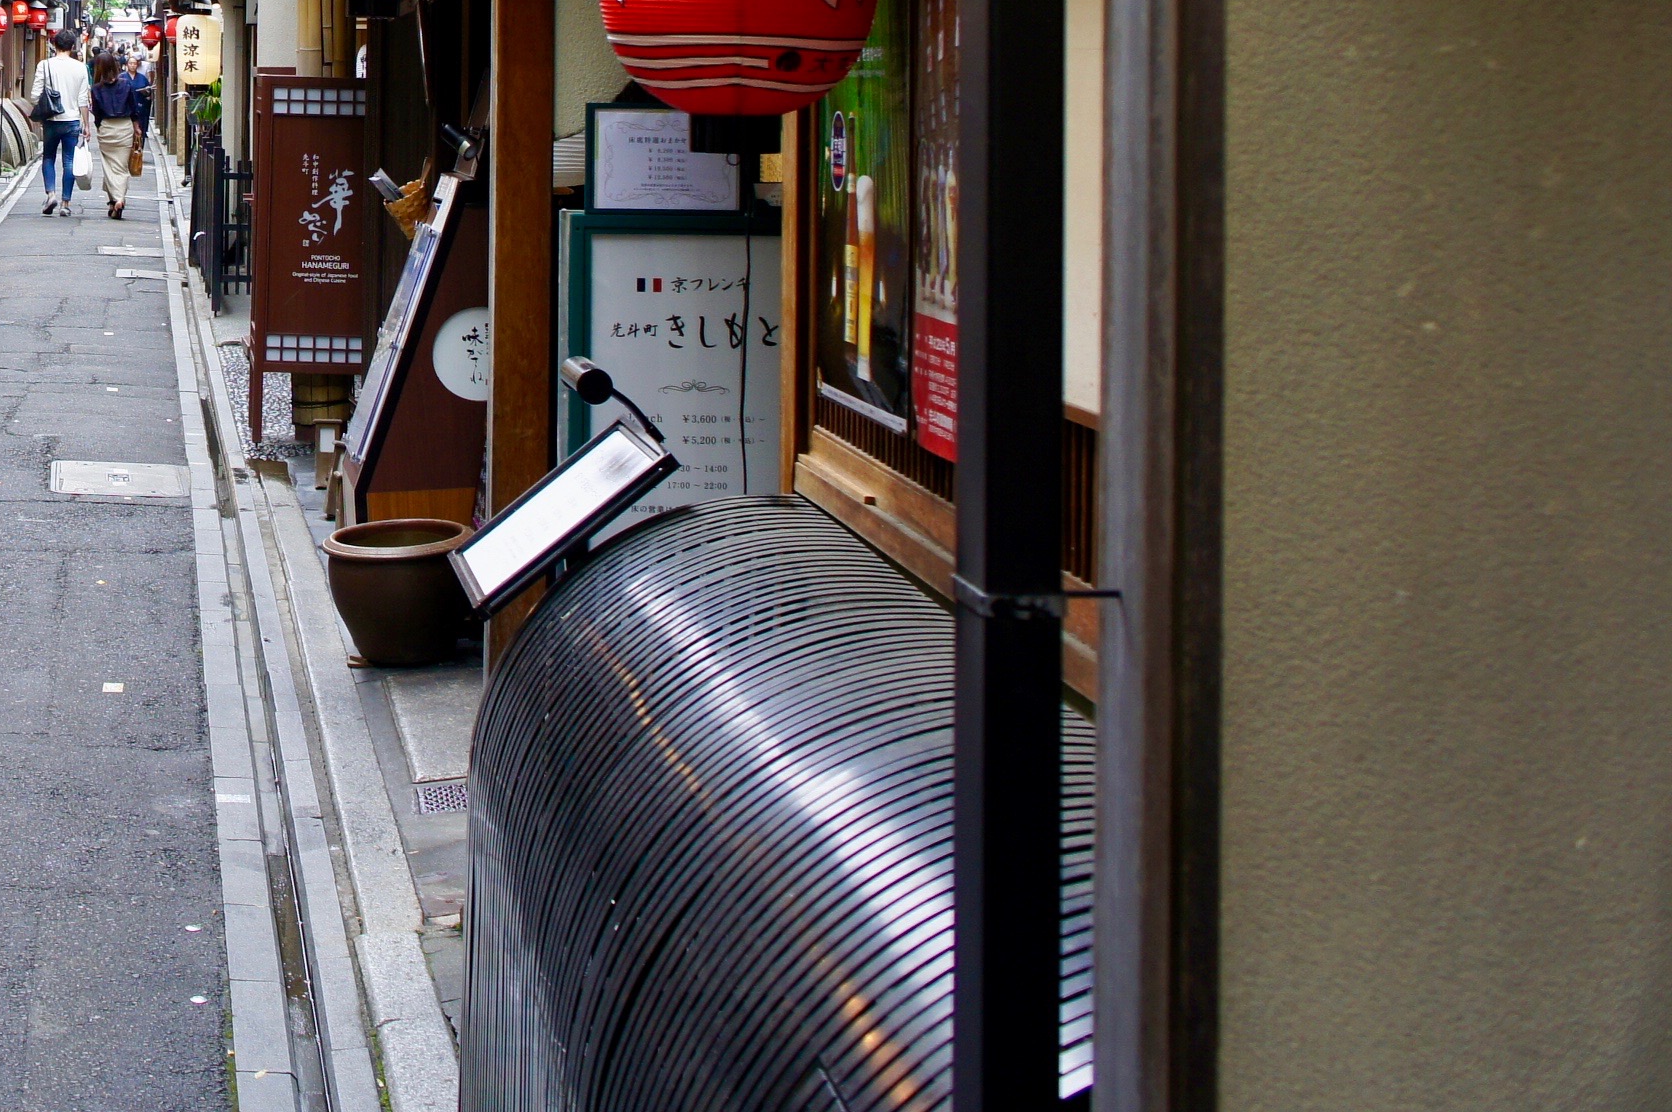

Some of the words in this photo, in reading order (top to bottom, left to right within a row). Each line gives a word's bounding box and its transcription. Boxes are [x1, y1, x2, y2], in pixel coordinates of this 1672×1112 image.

[182, 26, 200, 73] 納涼床
[310, 254, 341, 262] PONTOCHO
[301, 262, 350, 270] HANAMEGURI
[670, 276, 749, 293] 京フレンチ
[610, 322, 658, 338] 先斗町
[665, 312, 780, 350] きしもと
[682, 414, 717, 424] ¥3,600
[682, 435, 717, 445] ¥5,200
[704, 464, 728, 473] 14:00
[667, 481, 691, 490] 17:00
[704, 481, 728, 490] 22:00
